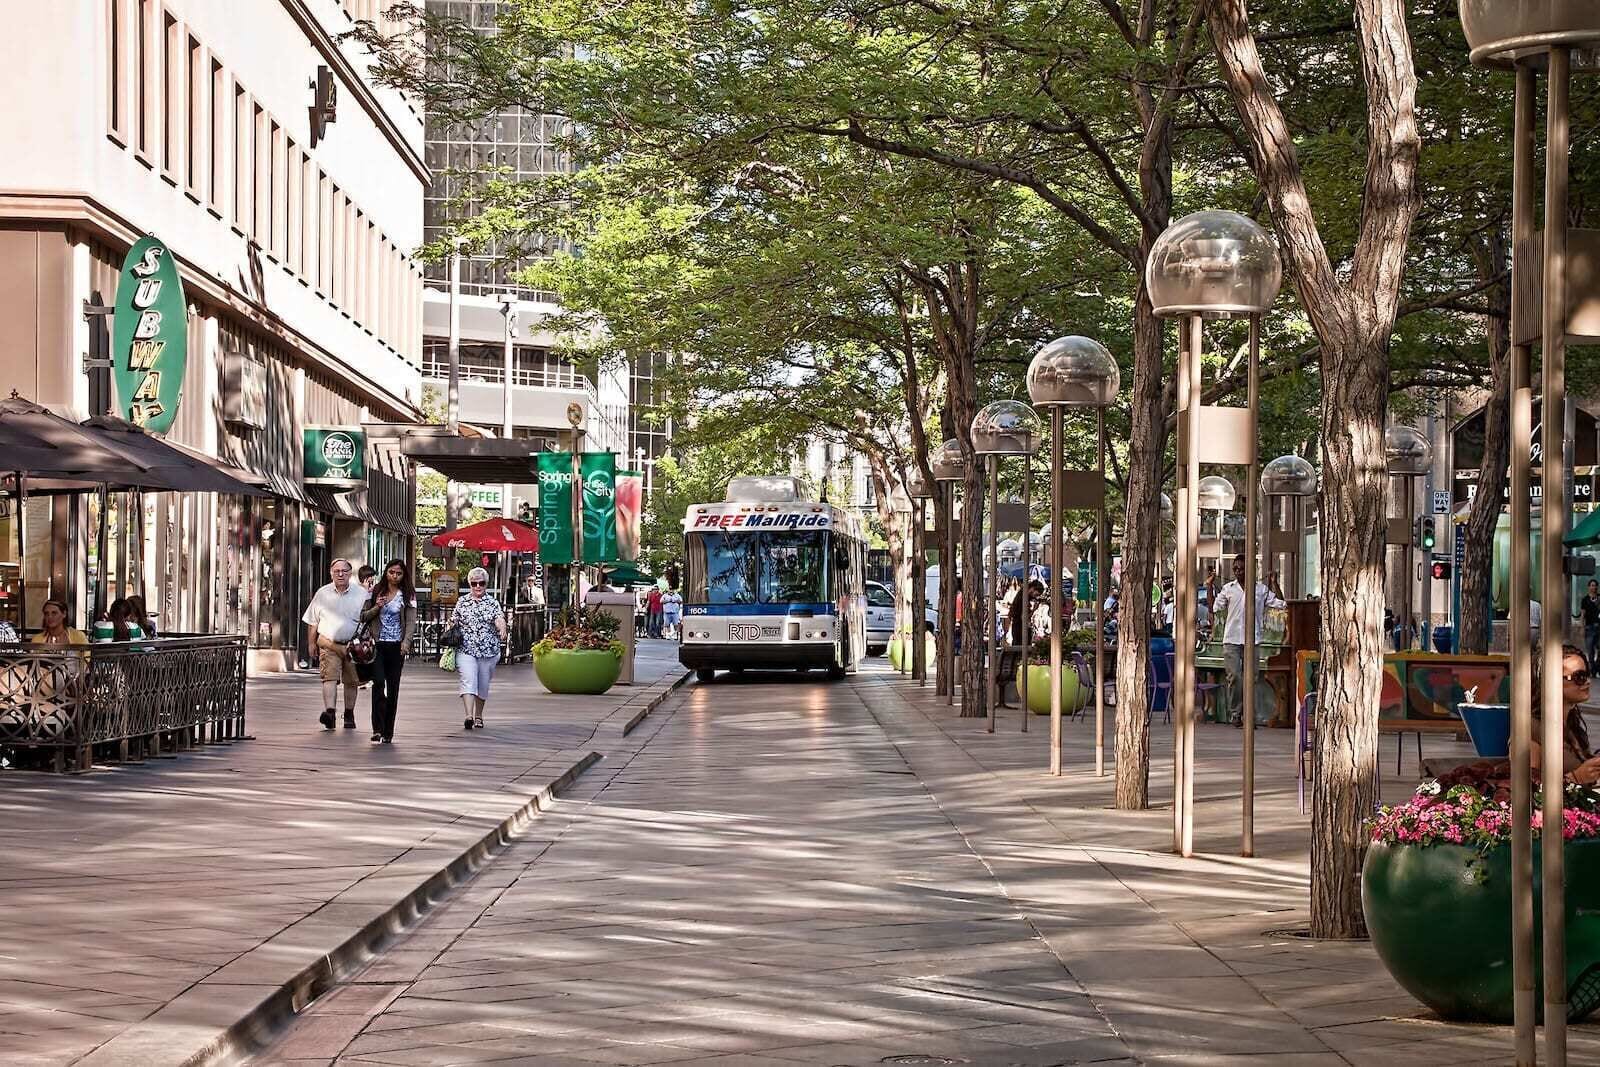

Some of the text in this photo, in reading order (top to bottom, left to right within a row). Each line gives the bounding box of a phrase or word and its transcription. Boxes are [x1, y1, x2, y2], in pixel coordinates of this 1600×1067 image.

[130, 246, 166, 428] SUBWAY
[324, 468, 352, 478] ATM
[539, 470, 571, 483] Spring
[471, 490, 500, 503] FFEE
[595, 487, 615, 497] city
[540, 480, 562, 544] Spring
[694, 514, 746, 527] FREE
[728, 624, 761, 641] RTD
